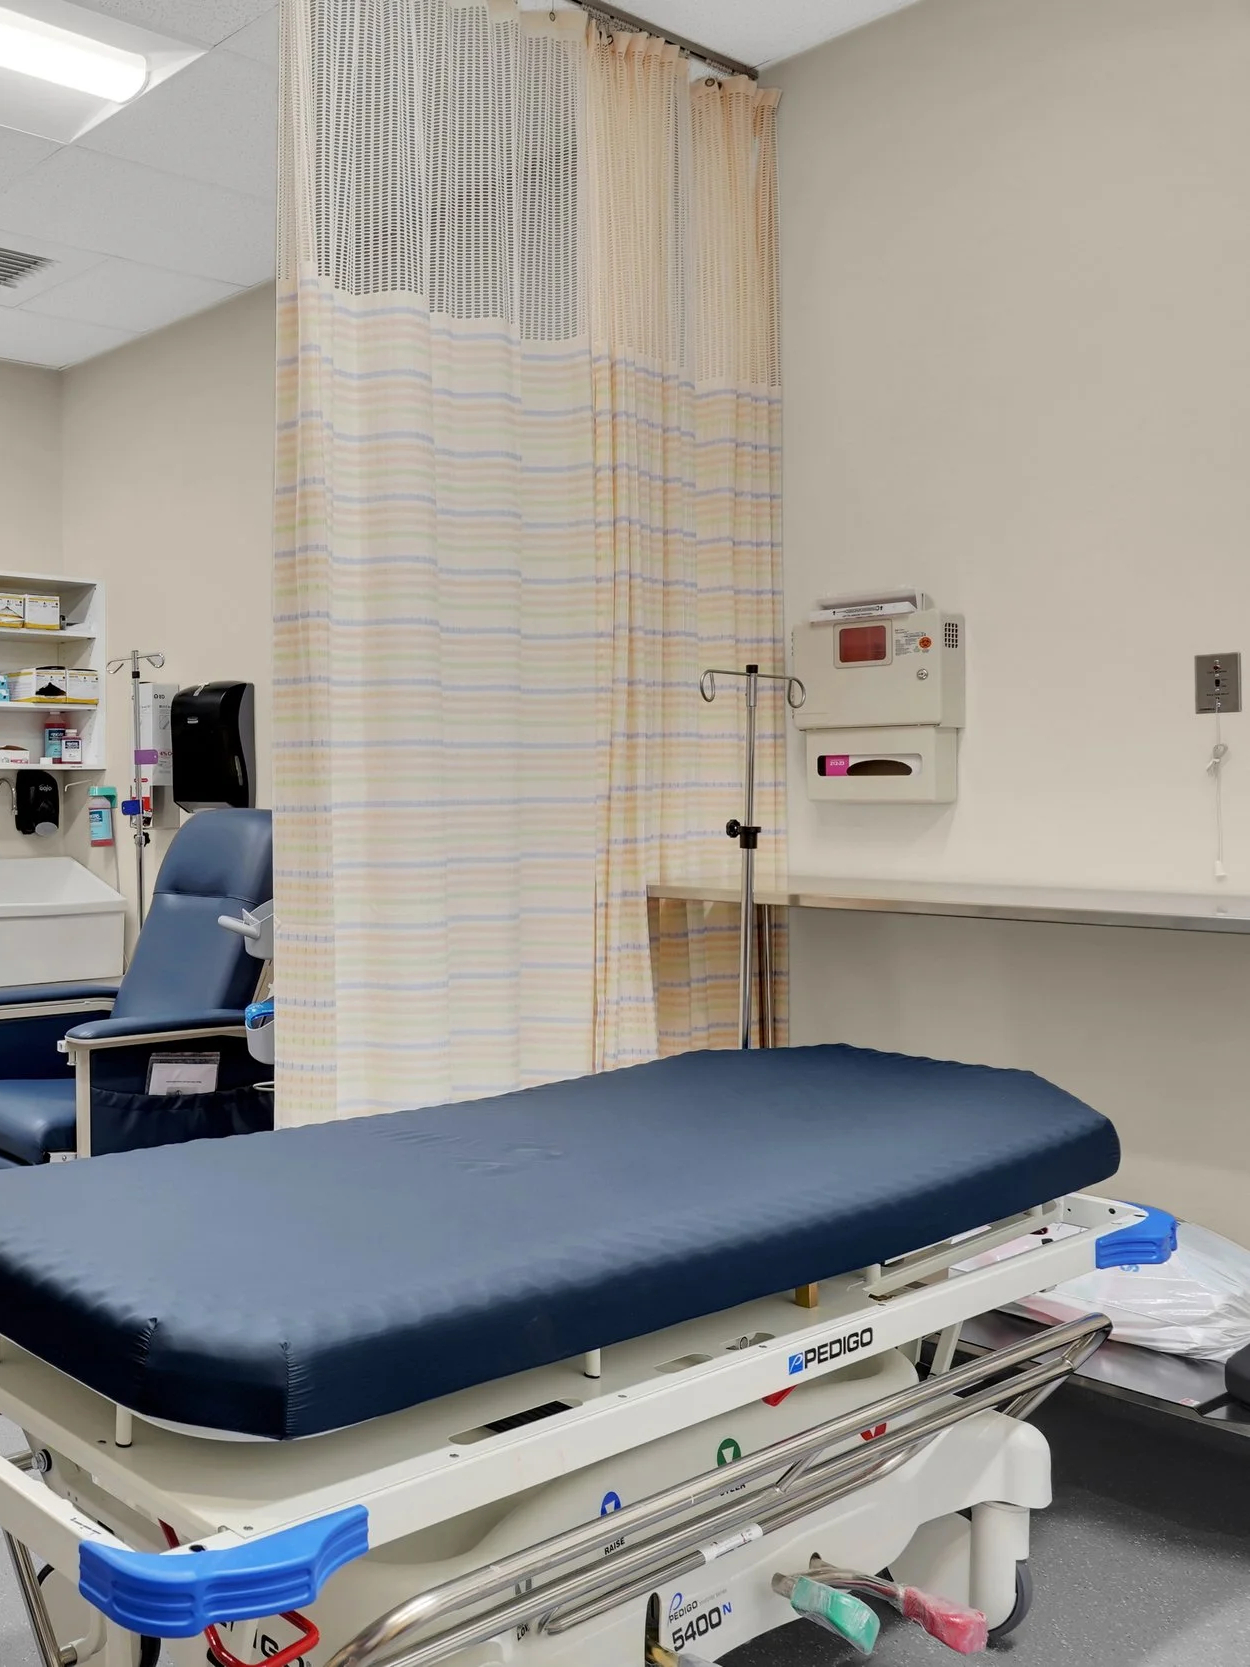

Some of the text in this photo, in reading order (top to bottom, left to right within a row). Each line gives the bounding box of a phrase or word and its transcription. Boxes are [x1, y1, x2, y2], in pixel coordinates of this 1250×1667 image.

[804, 1327, 874, 1369] PEDIGO
[604, 1537, 626, 1556] RAISE
[668, 1600, 698, 1624] PEDIGO
